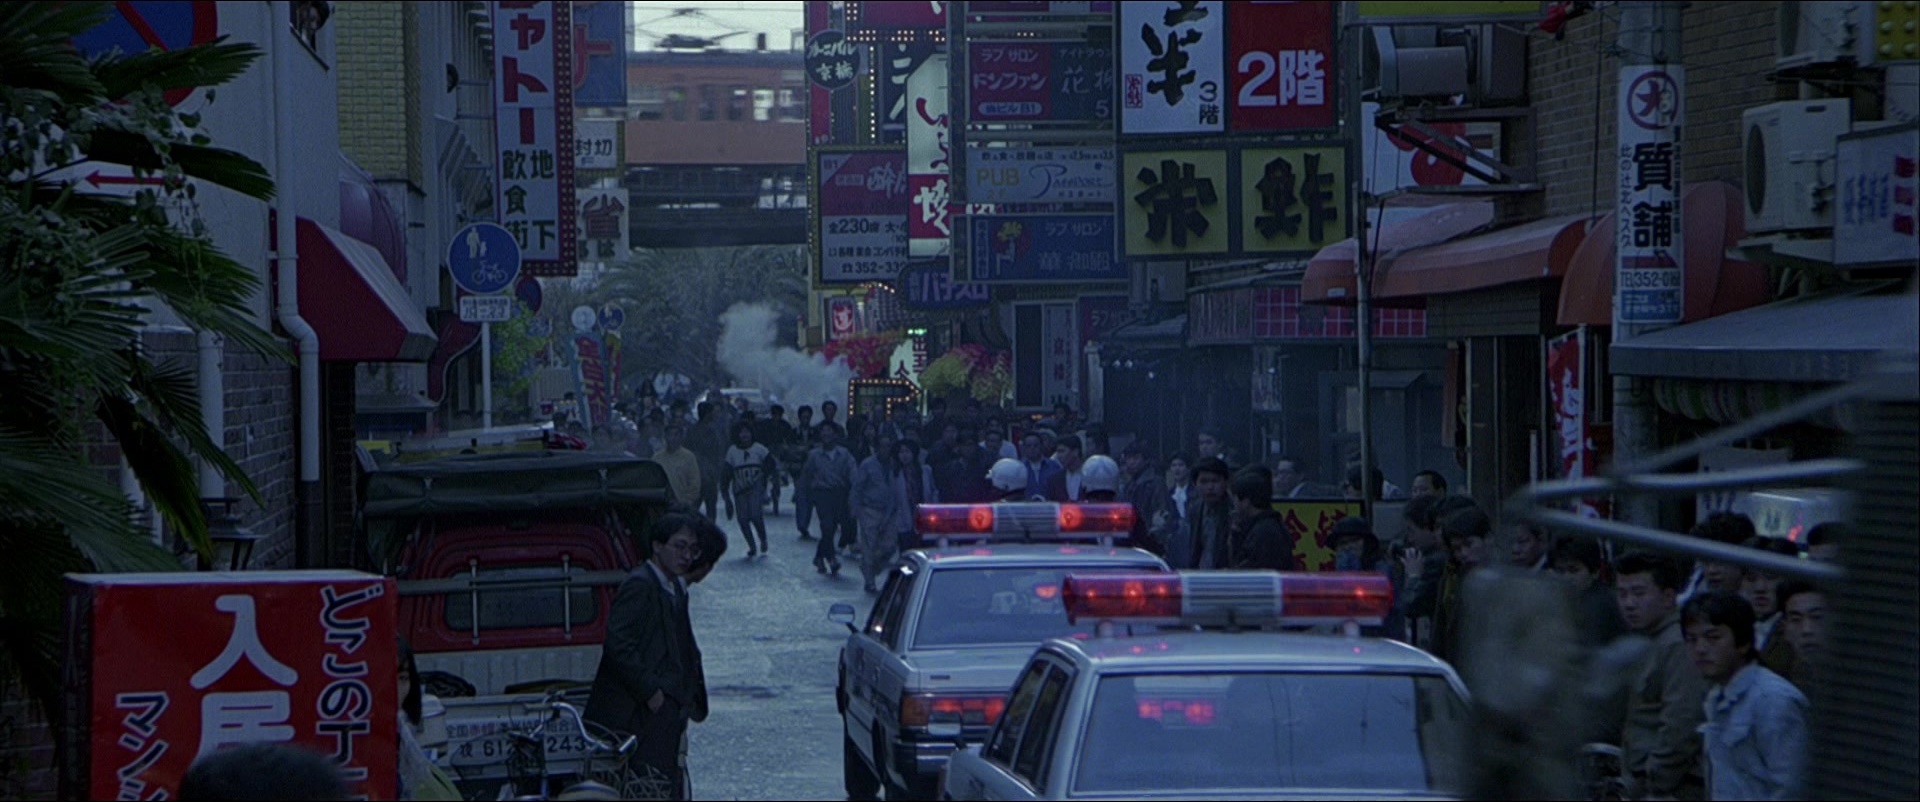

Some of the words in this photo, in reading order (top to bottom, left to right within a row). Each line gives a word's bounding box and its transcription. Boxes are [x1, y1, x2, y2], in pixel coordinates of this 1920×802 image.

[499, 1, 549, 144] ャトー
[973, 71, 1048, 91] ドンファン
[1238, 49, 1326, 107] 2階
[1199, 81, 1220, 124] 3階
[976, 168, 1020, 187] PUB
